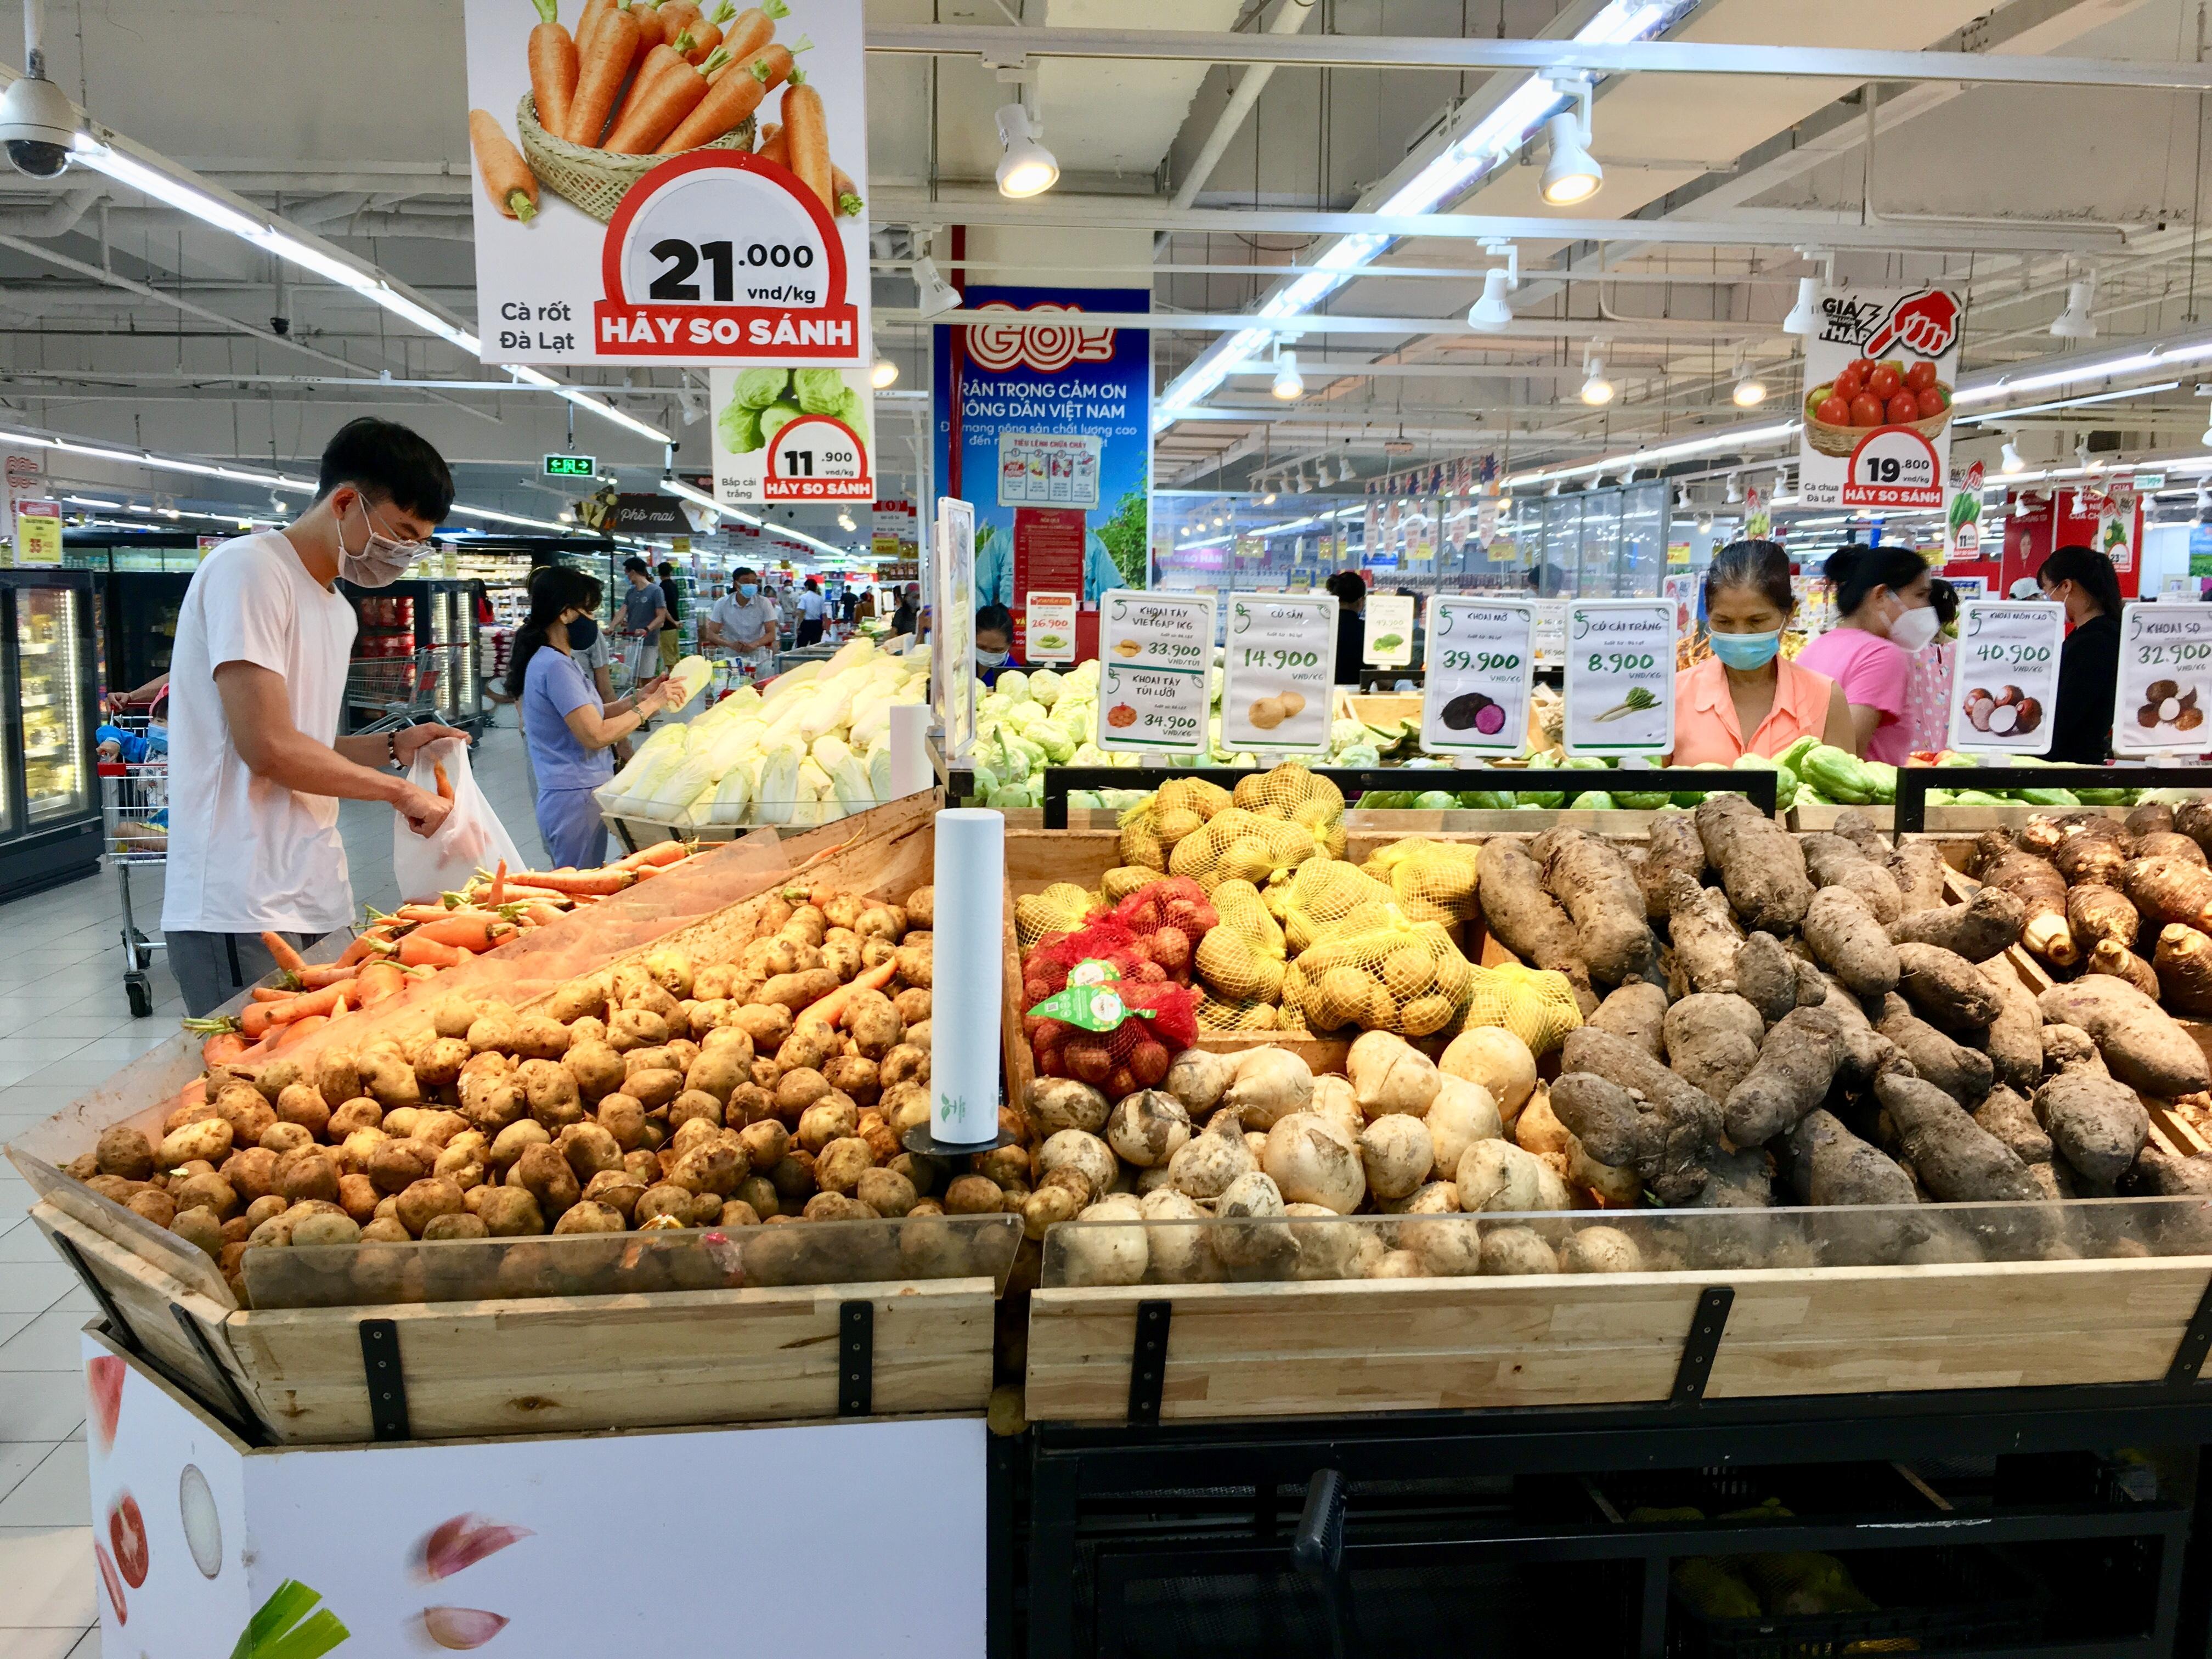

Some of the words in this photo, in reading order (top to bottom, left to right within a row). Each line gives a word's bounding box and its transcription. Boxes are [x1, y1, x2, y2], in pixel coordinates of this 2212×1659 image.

[748, 285, 816, 303] vnd/kg
[501, 302, 531, 320] Cà
[538, 301, 571, 321] rốt
[1822, 295, 1858, 317] GIÁ
[602, 311, 682, 343] HÃY
[689, 318, 740, 345] SO
[748, 313, 851, 346] SÁNH
[500, 330, 531, 349] Đà
[539, 331, 575, 353] Lạt
[963, 379, 994, 397] RÂN
[997, 383, 1056, 401] TRỌNG
[1059, 380, 1097, 398] CẢM
[1009, 399, 1045, 417] DÂN
[1049, 400, 1082, 422] VIỆT
[1087, 404, 1125, 419] NAM
[1115, 426, 1137, 435] cao
[767, 481, 799, 494] HÃY
[803, 483, 824, 494] SO
[827, 481, 870, 495] SÁNH
[1846, 487, 1876, 500] HÃY
[1878, 490, 1898, 501] SO
[1901, 489, 1940, 503] SÁNH
[620, 508, 647, 522] Phô
[650, 511, 675, 522] mai
[1140, 607, 1167, 616] KHOAI
[2147, 622, 2182, 634] KHOAI
[1148, 642, 1200, 657] 33.900
[1245, 648, 1318, 670] 14.900
[1977, 644, 2051, 664] 40.900
[2138, 644, 2211, 665] 32.900
[1443, 650, 1520, 672] 39.900
[1588, 653, 1655, 674] 8.900
[1132, 675, 1160, 684] KHOAI
[1136, 685, 1152, 696] TÚI
[1144, 714, 1197, 729] 34.900
